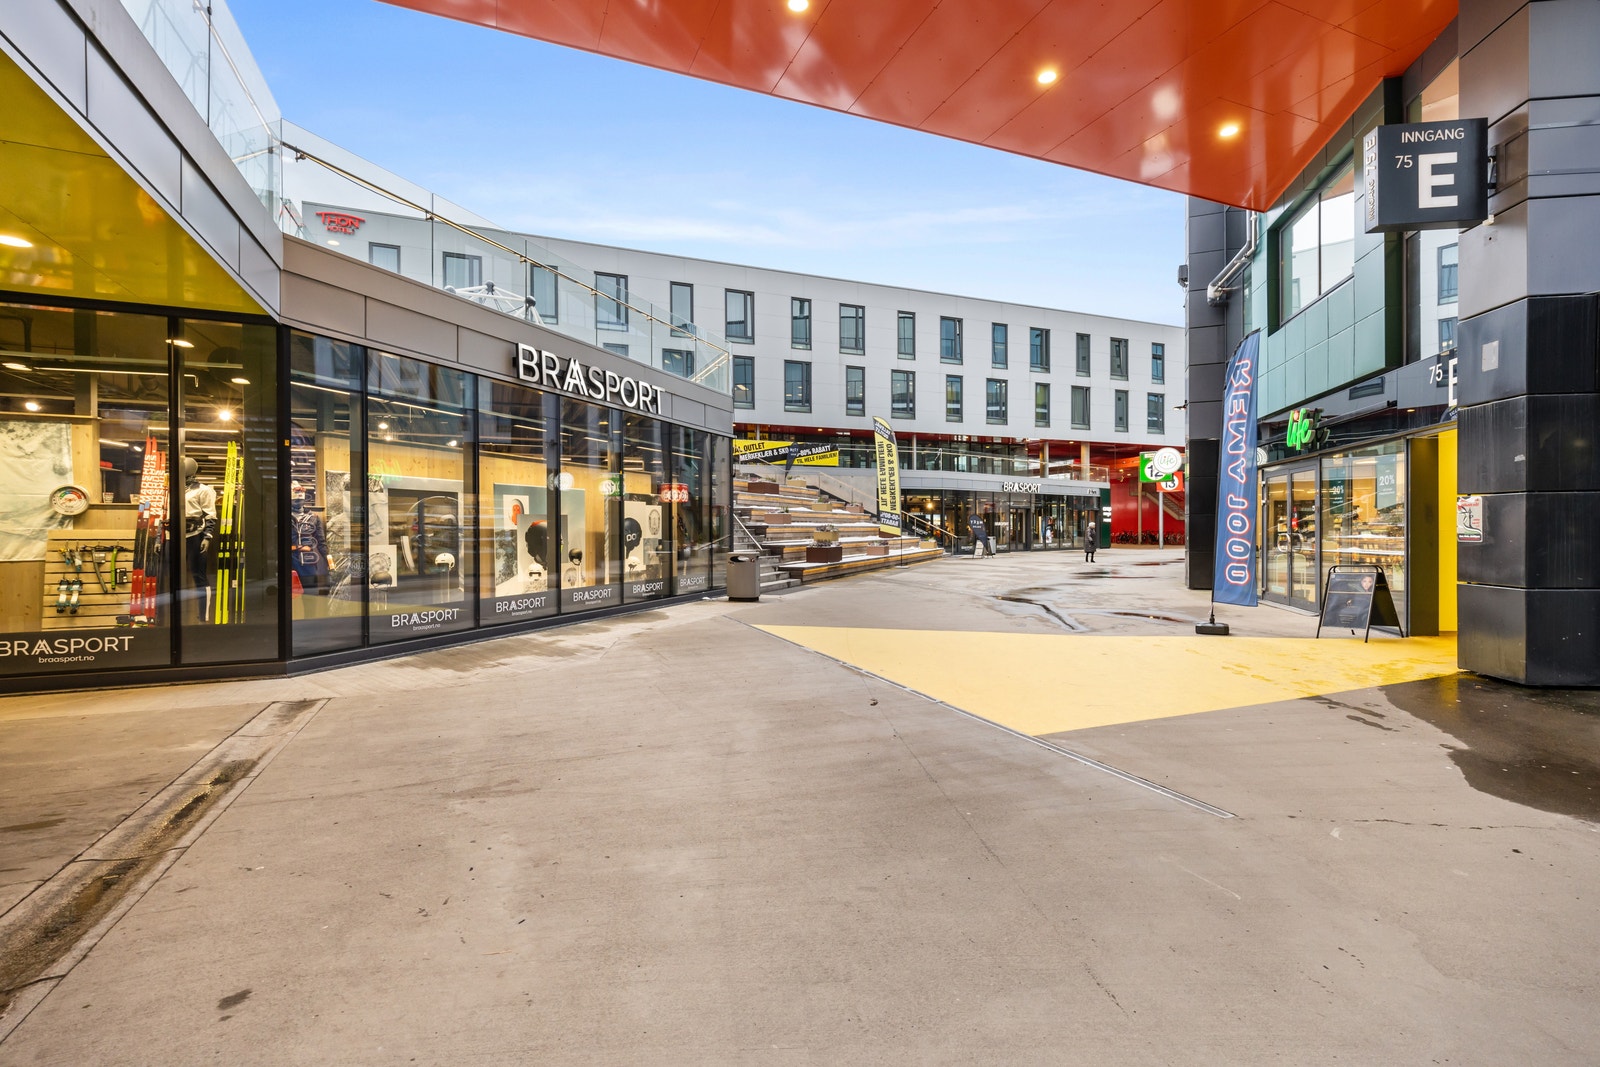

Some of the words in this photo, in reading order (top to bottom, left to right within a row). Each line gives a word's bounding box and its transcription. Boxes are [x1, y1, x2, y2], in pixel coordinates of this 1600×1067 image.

[1401, 127, 1465, 143] INNGANG
[1366, 135, 1377, 151] E
[1366, 152, 1377, 176] 75
[1394, 154, 1413, 169] 75
[1418, 151, 1459, 209] E
[315, 211, 366, 229] THON
[1428, 362, 1443, 385] 75
[743, 442, 765, 452] OUTLET
[778, 447, 789, 455] SKO
[1379, 474, 1395, 486] 20%
[412, 623, 441, 631] braasport.no
[38, 655, 95, 664] braasport.no
